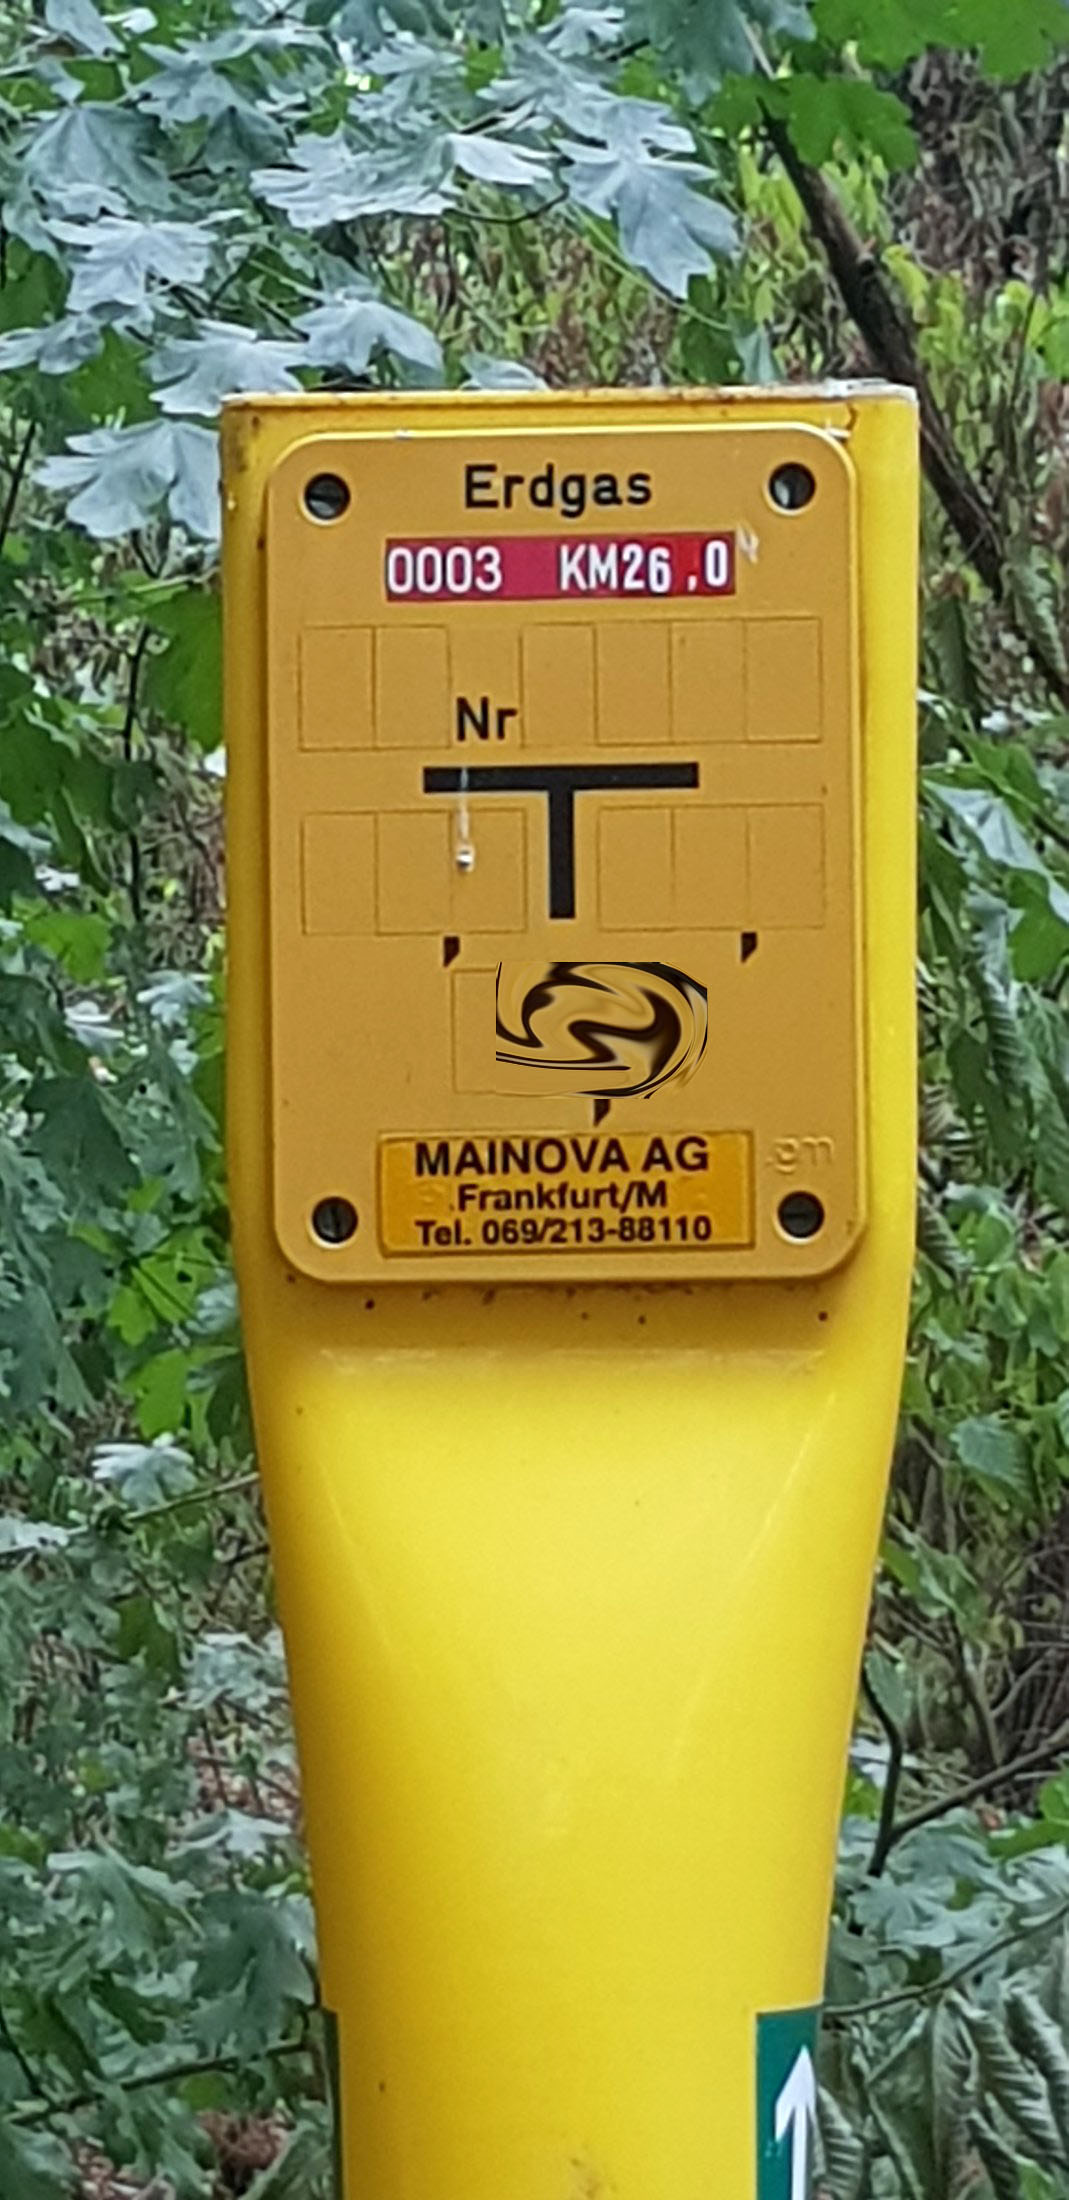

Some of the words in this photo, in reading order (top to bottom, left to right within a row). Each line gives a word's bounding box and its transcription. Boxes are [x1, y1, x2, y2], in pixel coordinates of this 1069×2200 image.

[464, 462, 653, 518] Erdgas
[387, 546, 502, 594] 0003
[456, 696, 518, 742] Nr
[414, 1136, 631, 1178] MAINOVA
[641, 1135, 710, 1173] AG
[457, 1180, 668, 1214] Frankfurt/M
[415, 1218, 473, 1247] Tel.
[481, 1215, 713, 1246] 069/213-88110
